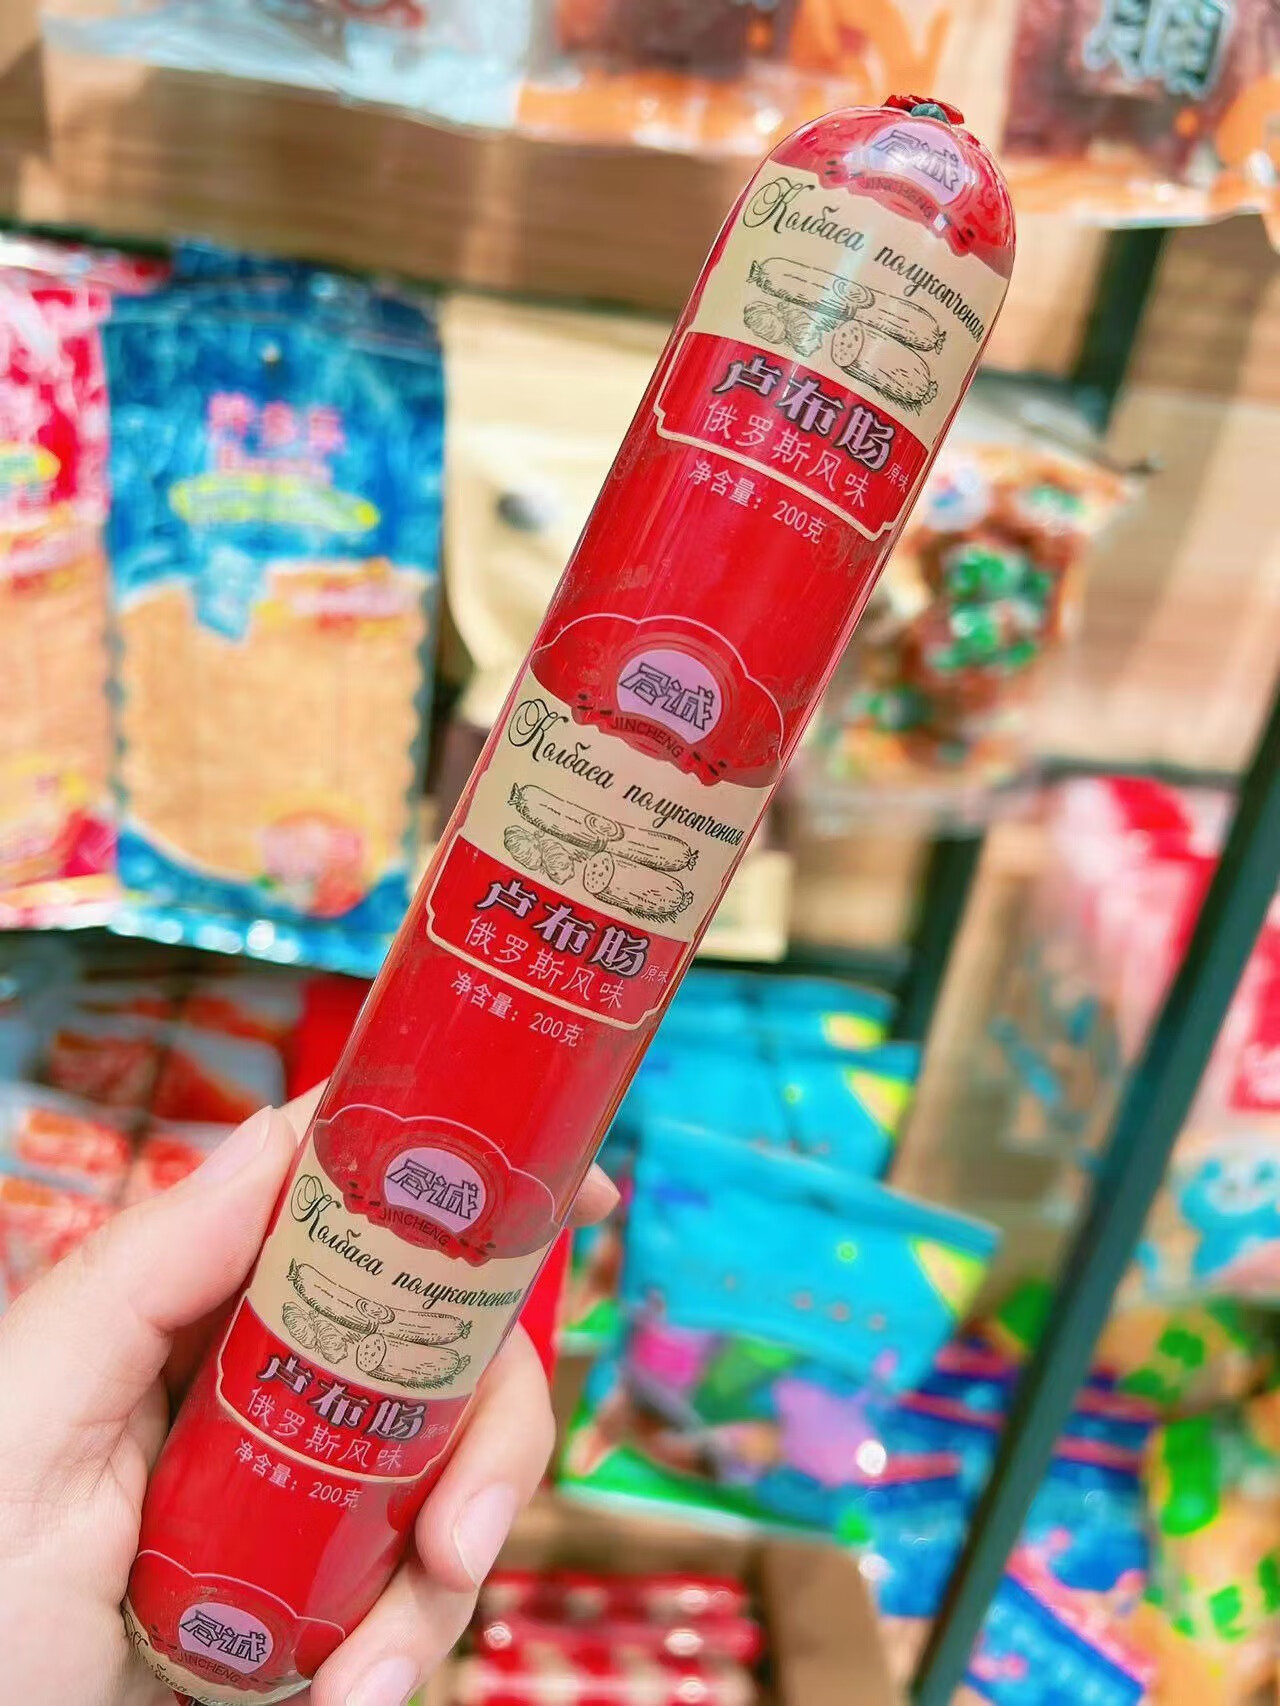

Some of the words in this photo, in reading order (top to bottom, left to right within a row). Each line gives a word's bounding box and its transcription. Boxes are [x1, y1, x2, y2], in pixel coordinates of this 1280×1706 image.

[742, 176, 867, 251] Колбаса
[702, 399, 867, 509] 俄罗斯风味
[714, 356, 896, 471] 卢布肠
[883, 462, 910, 493] 原味
[507, 697, 615, 790] Колбаса
[610, 714, 685, 758] JINCHENG
[464, 915, 626, 1010] 俄罗斯风味
[476, 879, 650, 980] 卢布肠
[641, 963, 670, 985] 原味
[289, 1174, 386, 1278] Колбаса
[379, 1207, 450, 1249] JINCHENG
[247, 1386, 405, 1471] 俄罗斯风味
[256, 1353, 428, 1442] 卢布肠
[177, 1652, 241, 1685] JINCHENG
